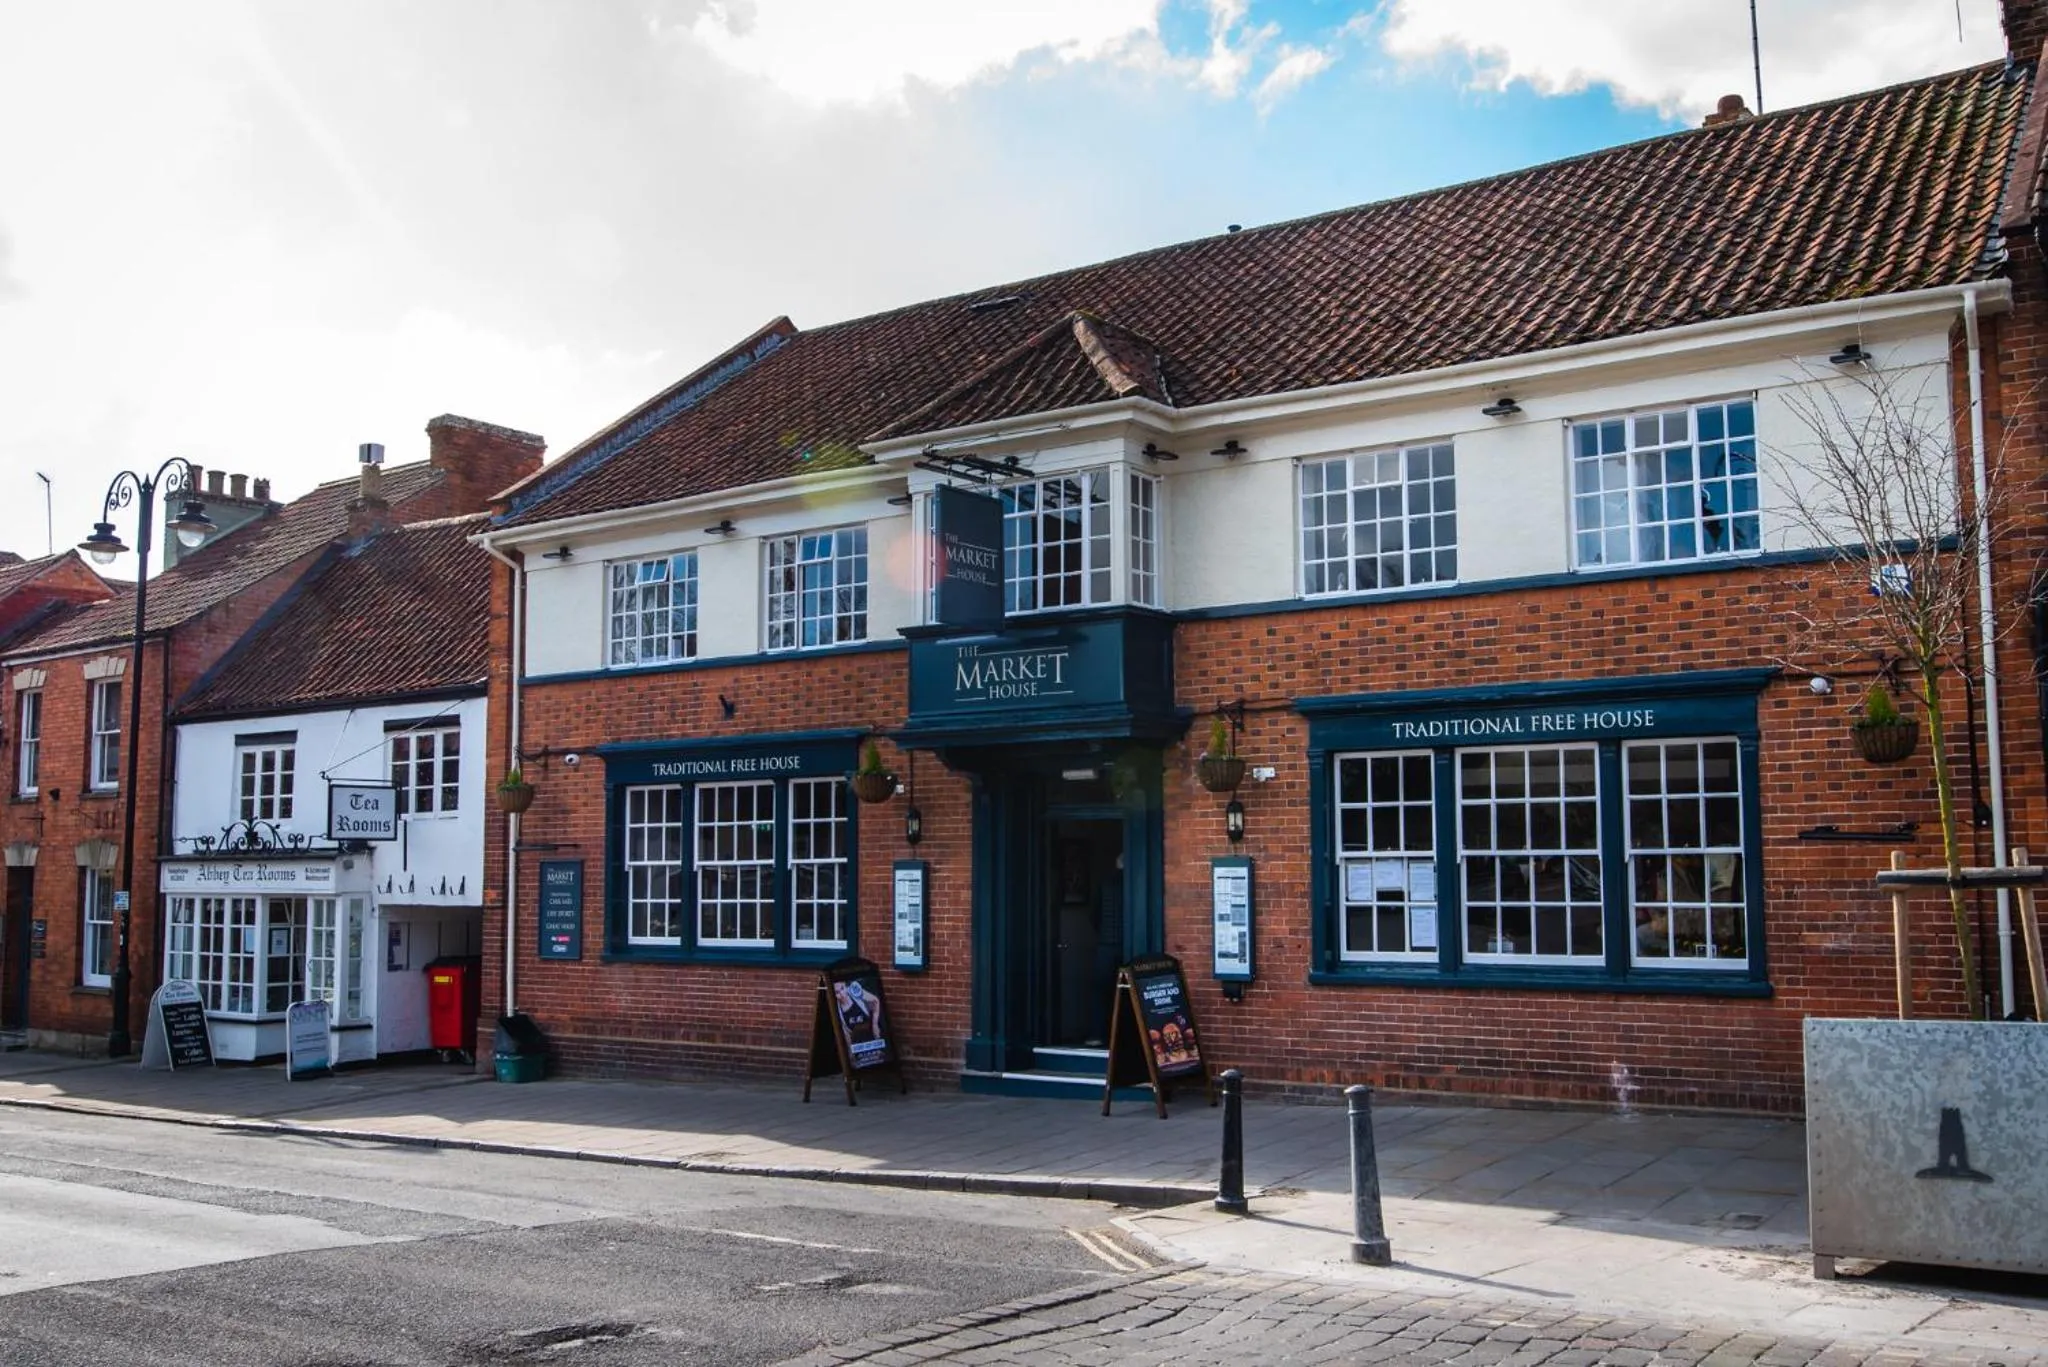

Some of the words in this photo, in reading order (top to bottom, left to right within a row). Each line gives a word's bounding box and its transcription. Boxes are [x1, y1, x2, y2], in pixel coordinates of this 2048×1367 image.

[945, 545, 999, 569] MARKET
[957, 568, 986, 584] HOUSE
[957, 645, 980, 658] THE
[955, 652, 1069, 691] MARKET
[989, 682, 1038, 699] HOUSE
[1392, 717, 1525, 739] TRADITIONAL
[1531, 713, 1576, 732] FREE
[1583, 709, 1654, 730] HOUSE
[652, 760, 728, 776] TRADITIONAL
[731, 758, 757, 772] FREE
[760, 756, 801, 771] HOUSE
[350, 794, 379, 811] Tea
[336, 814, 391, 833] Rooms
[197, 863, 231, 884] Abbey
[232, 863, 253, 881] Tea
[255, 863, 296, 883] Rooms
